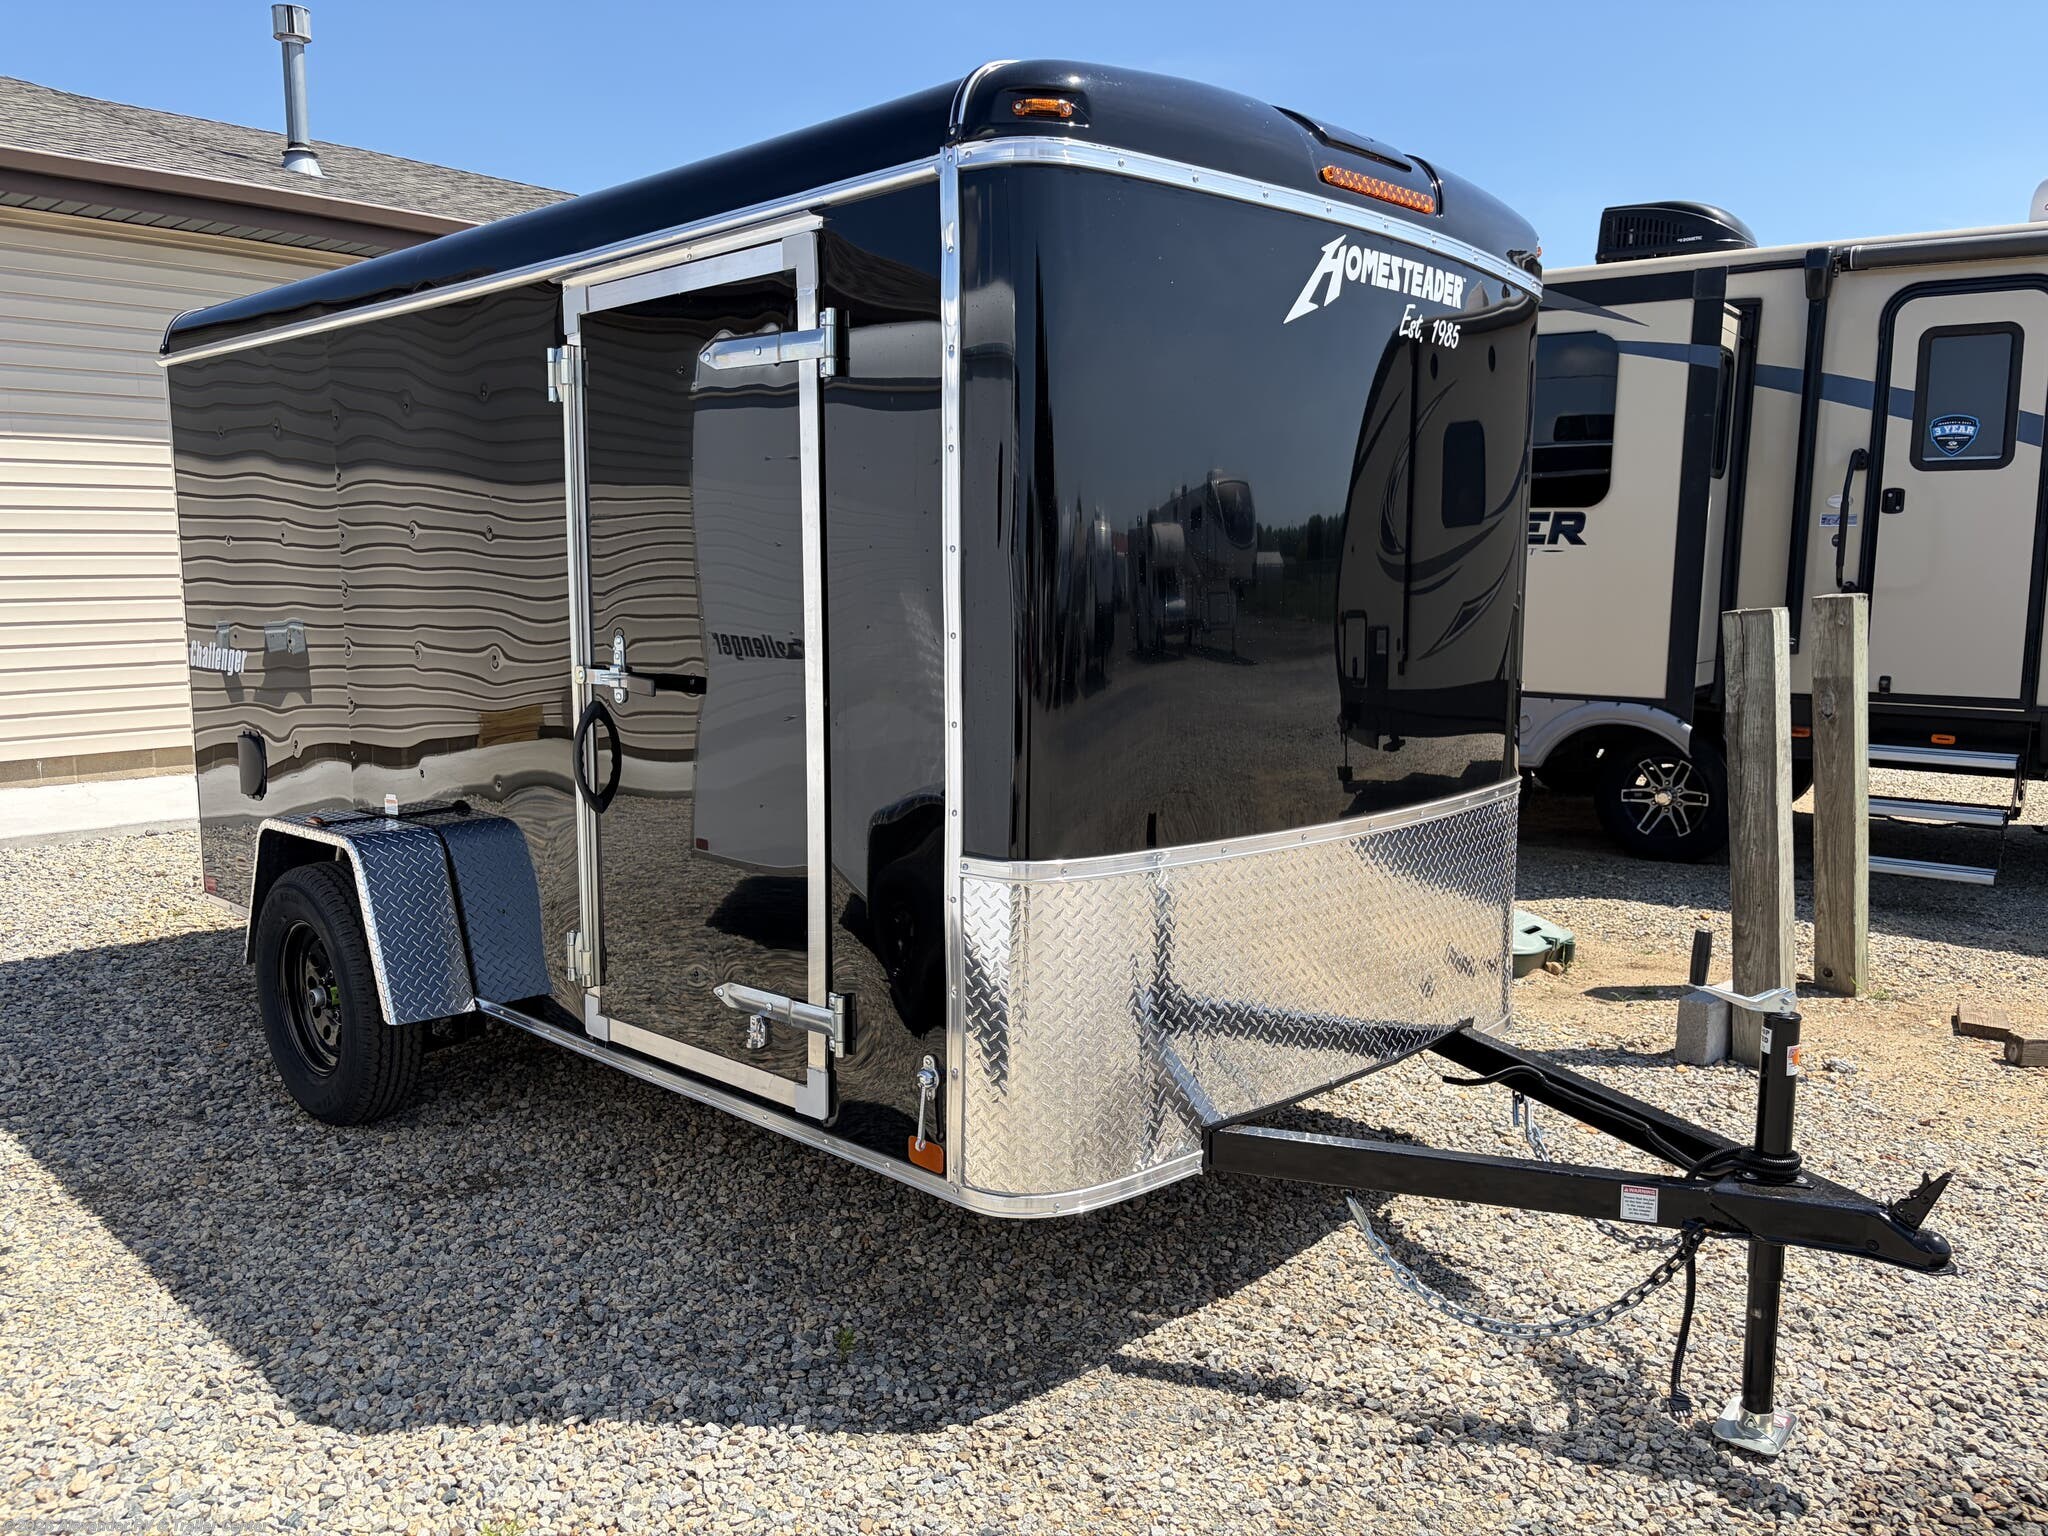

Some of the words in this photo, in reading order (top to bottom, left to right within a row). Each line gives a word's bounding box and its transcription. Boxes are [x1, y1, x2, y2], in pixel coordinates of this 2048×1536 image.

[1283, 234, 1465, 325] HOMESTEADER
[1398, 303, 1424, 343] Est.
[1431, 319, 1462, 349] 1985
[1935, 427, 1941, 435] 3
[1944, 425, 1974, 435] YEAR
[190, 640, 248, 676] Challenger
